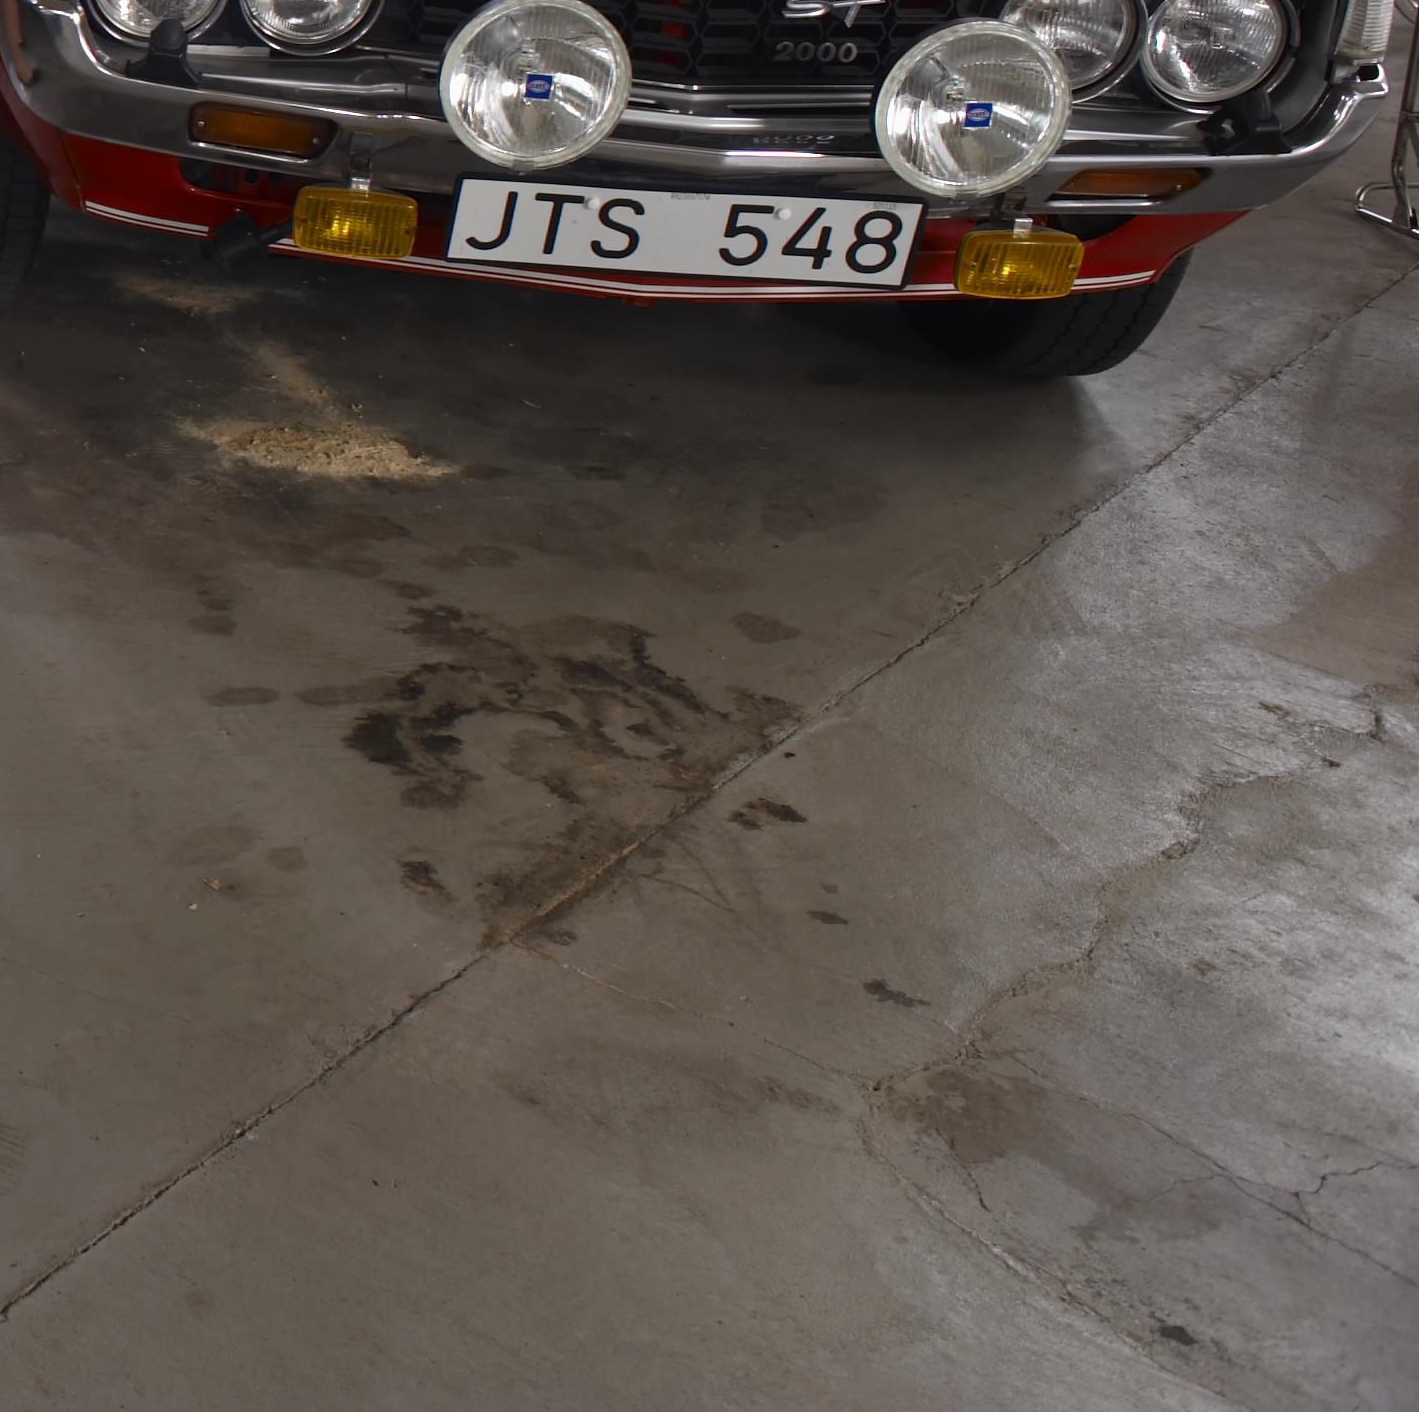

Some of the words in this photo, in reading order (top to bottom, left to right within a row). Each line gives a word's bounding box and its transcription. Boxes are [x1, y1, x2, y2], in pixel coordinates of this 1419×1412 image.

[773, 41, 858, 63] 2000
[464, 190, 645, 258] JTS
[718, 205, 904, 273] 548
